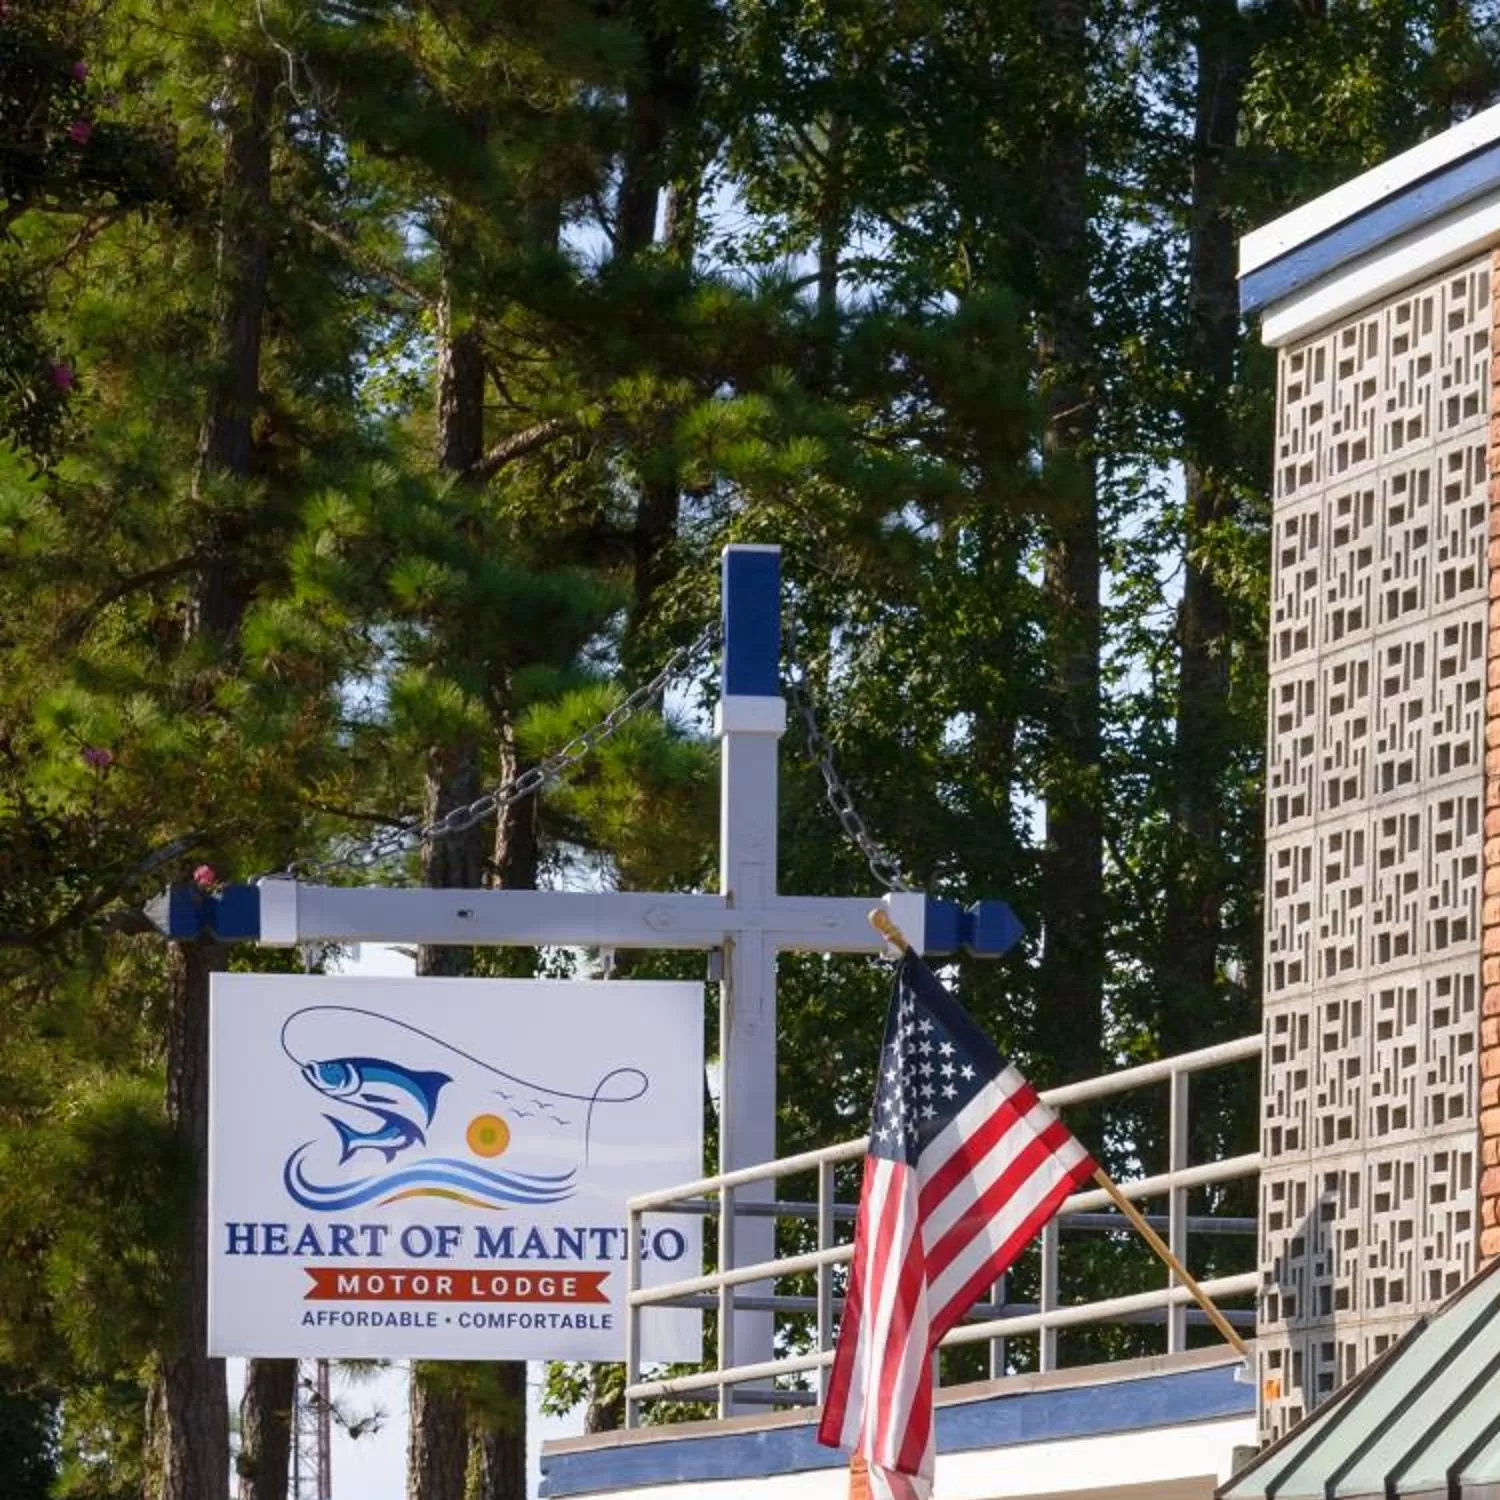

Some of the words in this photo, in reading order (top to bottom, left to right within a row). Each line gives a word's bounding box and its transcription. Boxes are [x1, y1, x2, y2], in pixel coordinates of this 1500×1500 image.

[224, 1222, 388, 1257] HEART
[400, 1224, 463, 1258] OF
[337, 1275, 454, 1295] MOTOR
[470, 1276, 579, 1297] LODGE
[302, 1311, 438, 1328] AFFORDABLE
[458, 1313, 614, 1331] COMFORTABLE
